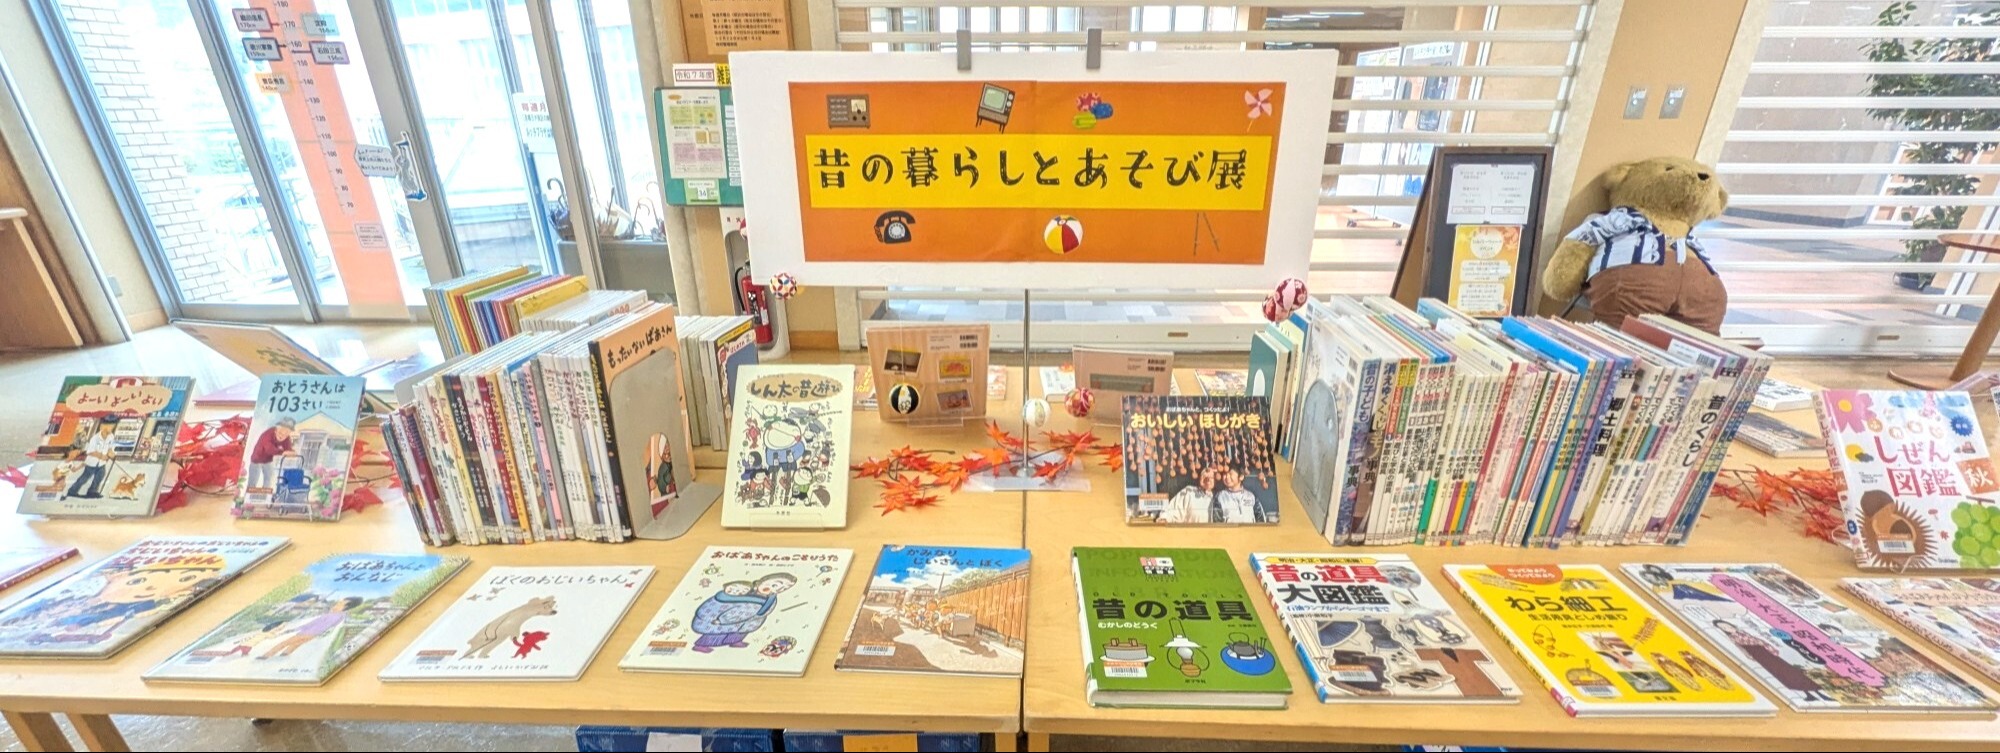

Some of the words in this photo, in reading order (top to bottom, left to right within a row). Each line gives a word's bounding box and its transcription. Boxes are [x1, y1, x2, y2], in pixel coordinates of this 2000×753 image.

[814, 146, 1247, 190] 昔の暮らしとあそび展
[607, 325, 673, 369] もったいないばあさん
[272, 379, 346, 395] おとうさんは
[750, 379, 841, 399] しん太の昔遊び
[77, 391, 108, 405] よーい
[111, 390, 142, 407] よーい
[142, 395, 163, 406] よい
[269, 396, 322, 413] 103さい
[1131, 412, 1194, 428] おいしい
[1200, 412, 1261, 429] ほしがき
[1592, 397, 1625, 457] 郷土料理
[1683, 395, 1726, 467] 昔のくらし
[1874, 436, 1950, 464] しぜん
[1886, 468, 1961, 498] 図鑑
[1965, 467, 1994, 488] 秋
[711, 551, 839, 562] おばあちゃんのこもりうた
[906, 549, 958, 557] かみなり
[335, 561, 426, 572] おばあちゃんと
[913, 558, 975, 567] じいさんと
[979, 559, 1003, 567] ぼく
[334, 572, 403, 582] おんなじ
[490, 574, 628, 585] ぼくのおじいちゃん
[1266, 564, 1390, 583] 昔の道具
[1277, 584, 1391, 604] 大図鑑
[1092, 598, 1253, 621] 昔の道具
[1505, 596, 1628, 612] わら細工
[1528, 613, 1628, 621] 生活用具としめ飾り
